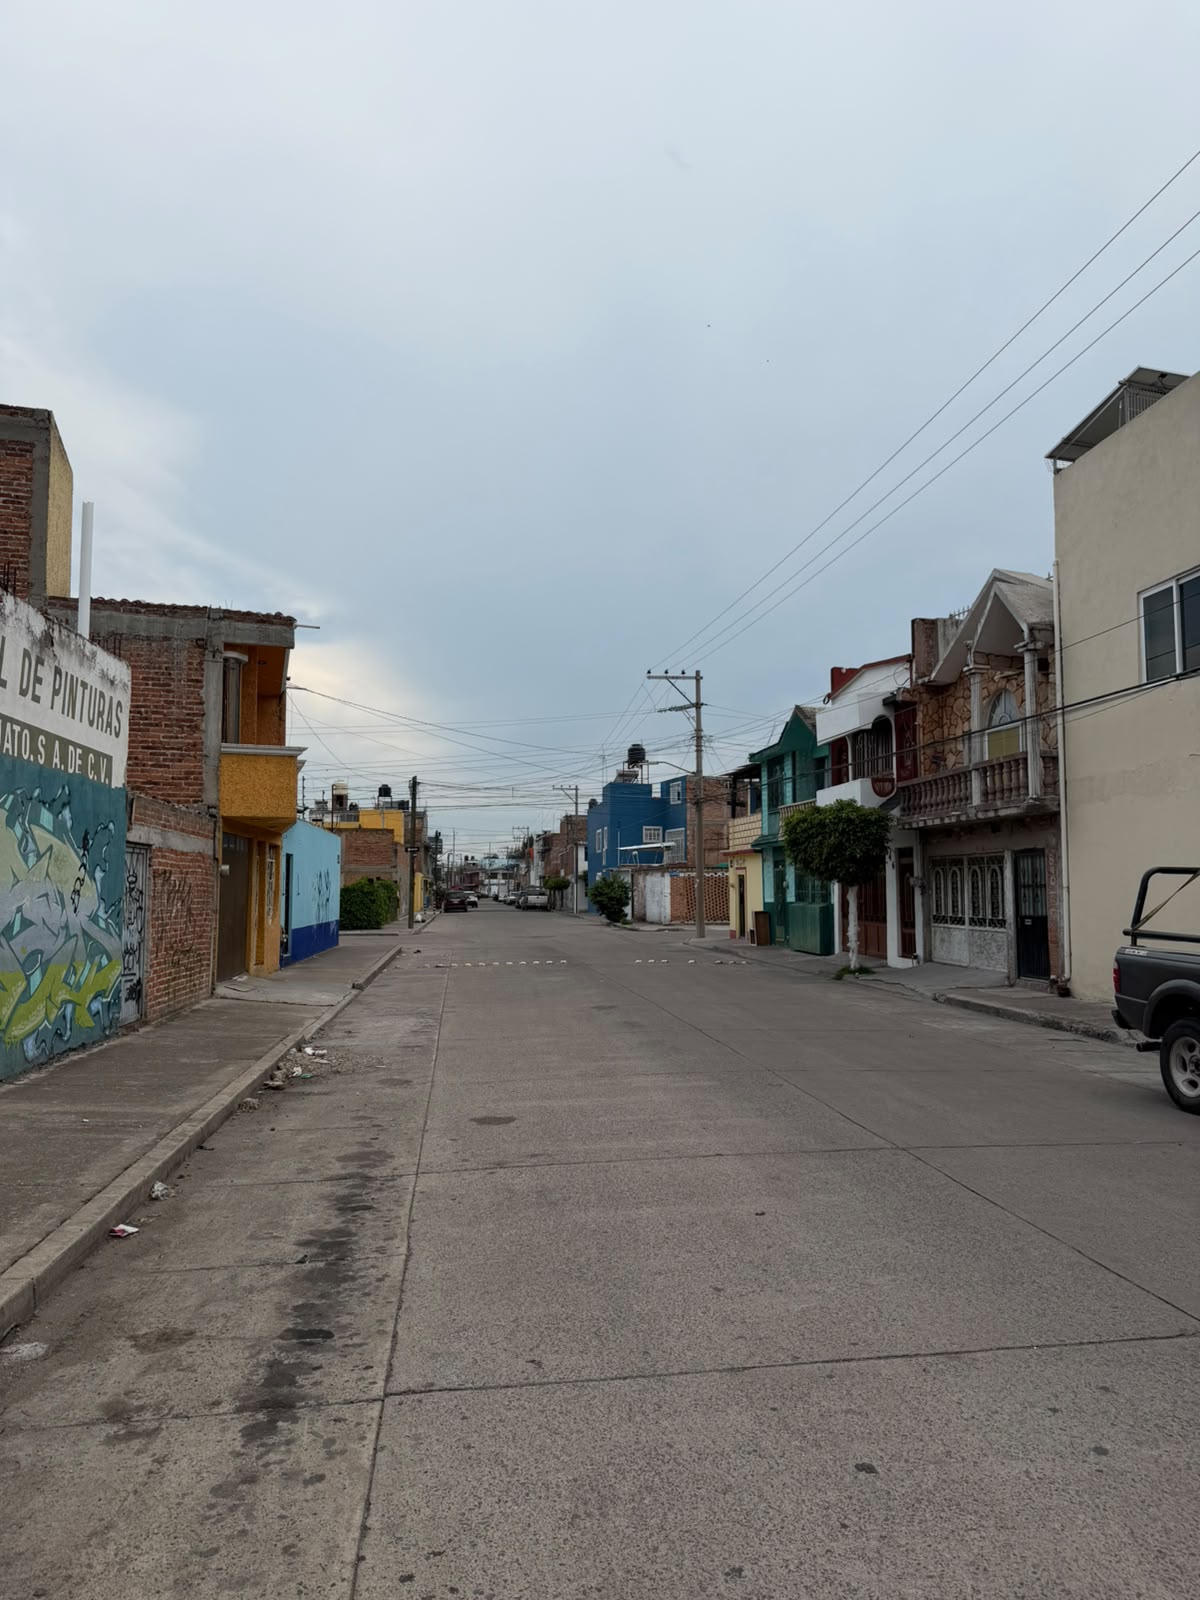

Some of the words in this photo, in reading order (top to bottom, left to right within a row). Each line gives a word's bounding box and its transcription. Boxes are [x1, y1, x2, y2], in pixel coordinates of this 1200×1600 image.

[19, 647, 45, 704] DE
[51, 665, 123, 738] PINTURAS
[0, 719, 34, 762] ATO.
[67, 745, 82, 774] DE
